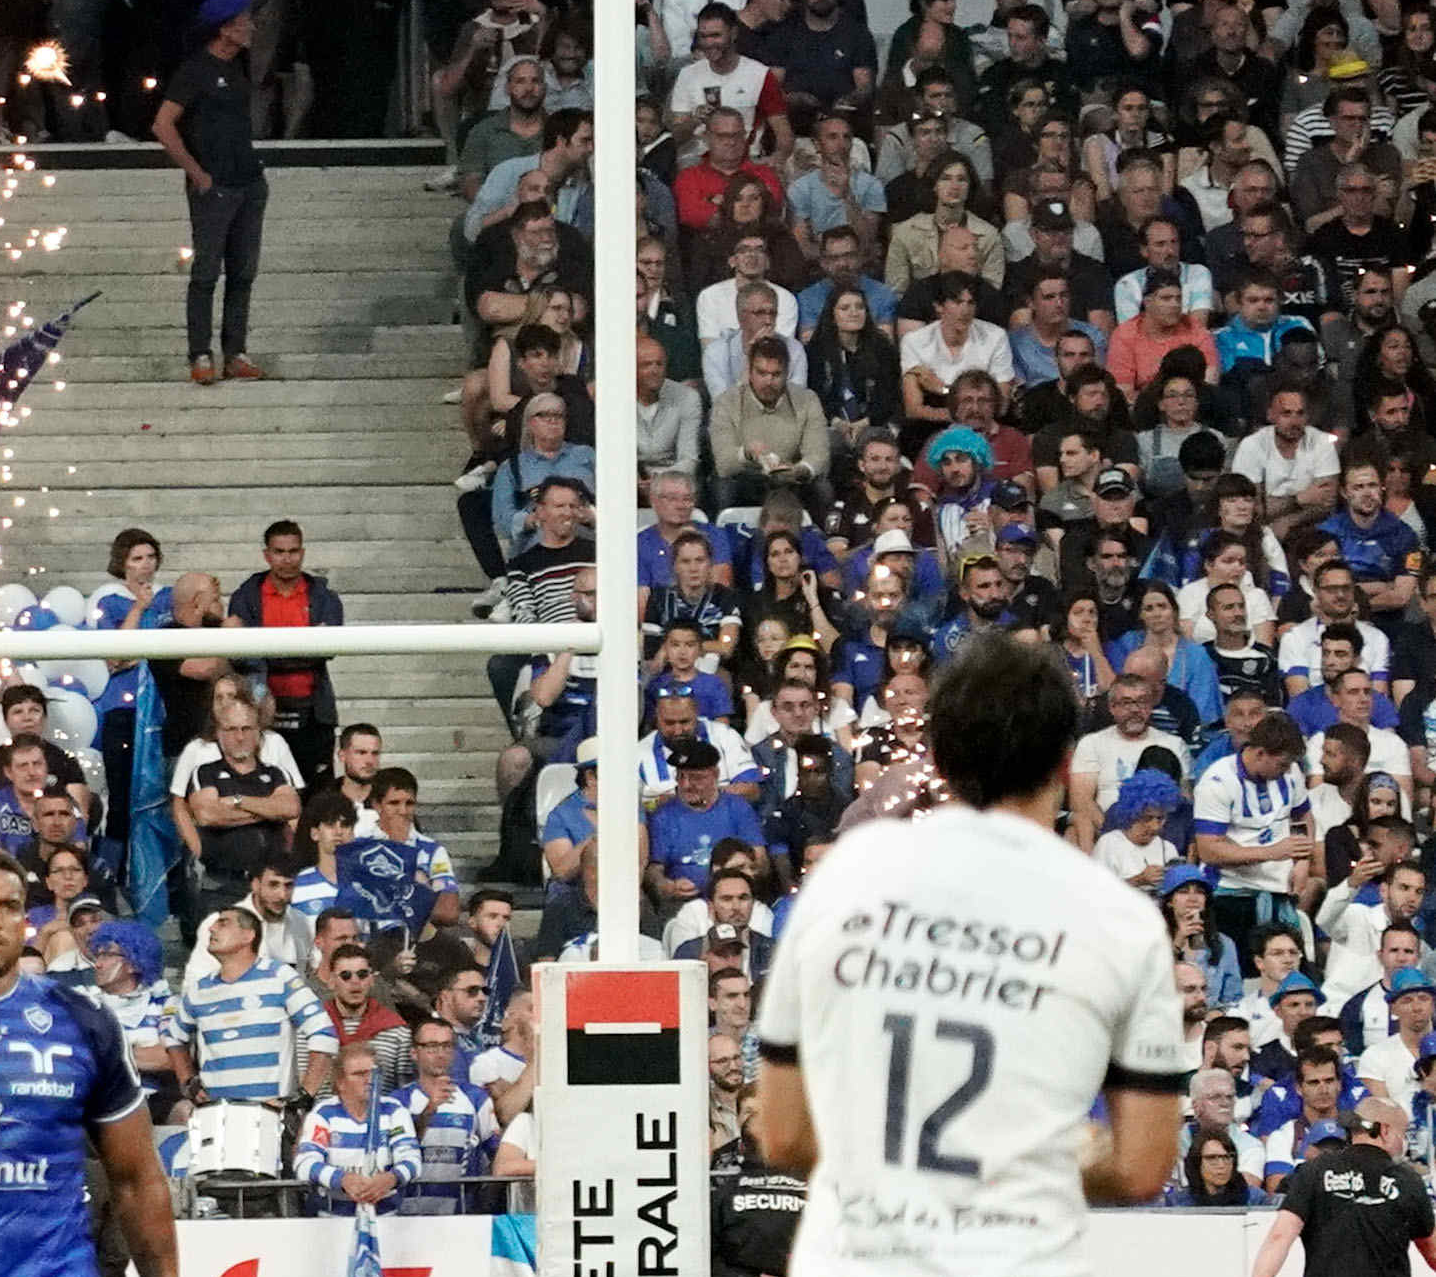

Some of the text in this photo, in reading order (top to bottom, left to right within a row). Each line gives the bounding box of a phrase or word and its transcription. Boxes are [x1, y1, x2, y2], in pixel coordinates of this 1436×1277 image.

[883, 900, 1067, 967] Tressol
[834, 945, 1058, 1012] Chabrier
[10, 1081, 74, 1098] randstad
[883, 1012, 997, 1179] 12
